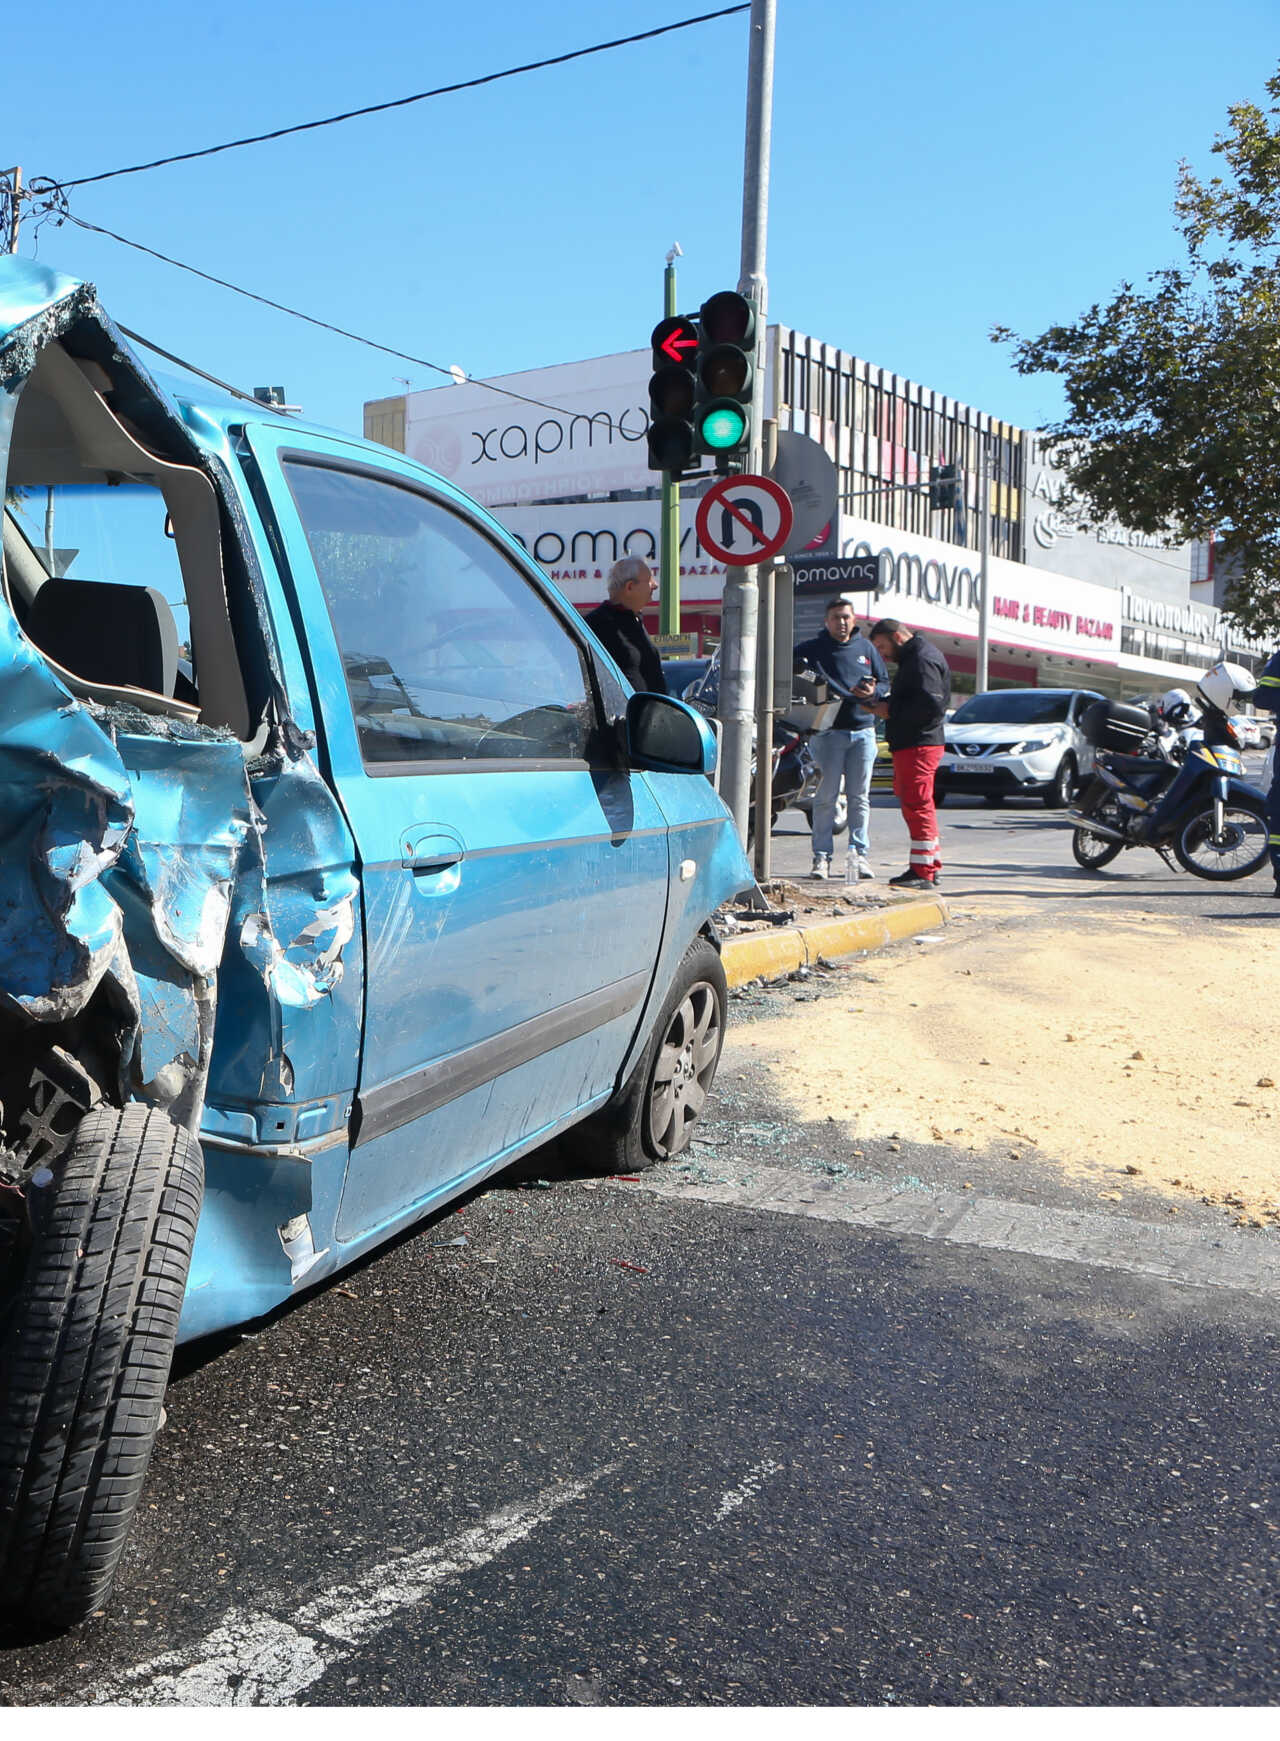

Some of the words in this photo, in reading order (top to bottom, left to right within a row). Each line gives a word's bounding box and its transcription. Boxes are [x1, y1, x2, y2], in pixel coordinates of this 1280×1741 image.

[551, 569, 588, 580] HAIR
[593, 568, 603, 579] &
[993, 596, 1020, 620] HAIR
[1022, 603, 1031, 624] &
[1032, 606, 1073, 632] BEAUTY
[1076, 616, 1113, 641] BAZAAR
